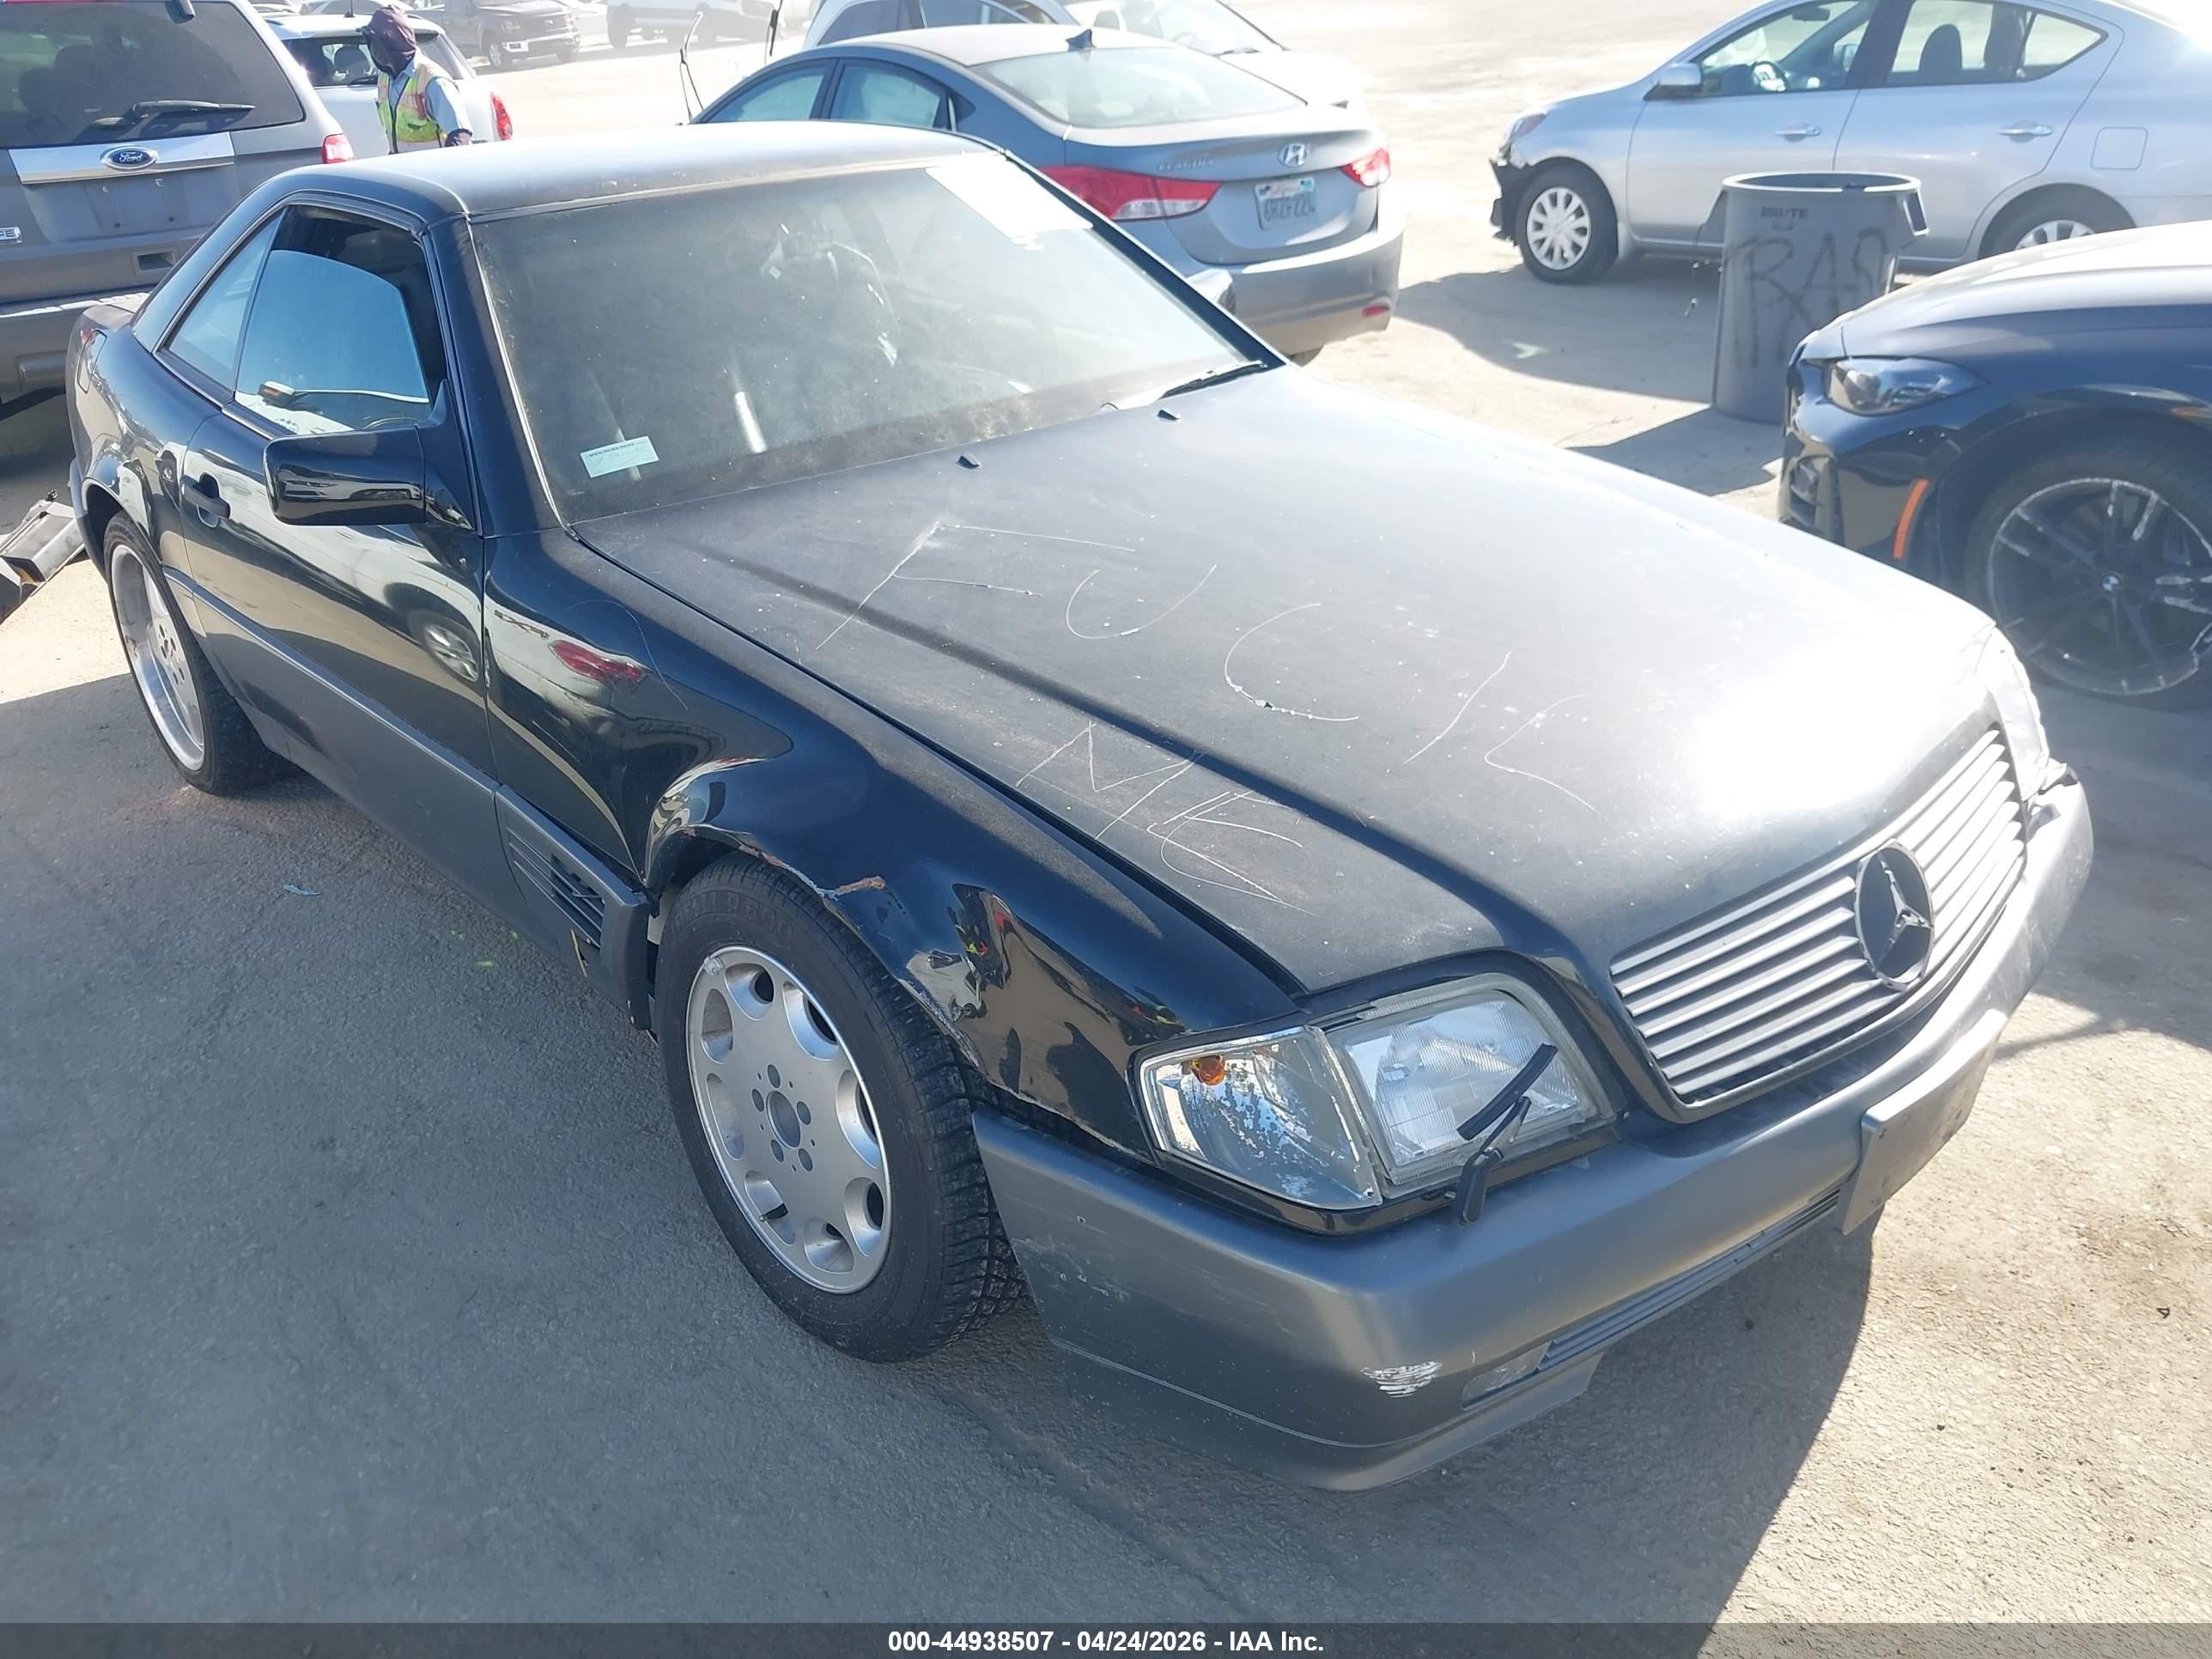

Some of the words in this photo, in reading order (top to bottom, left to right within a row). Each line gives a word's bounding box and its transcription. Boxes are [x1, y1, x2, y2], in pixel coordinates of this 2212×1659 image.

[119, 151, 143, 163] Ford
[1760, 206, 1809, 219] BRUTE
[816, 522, 1602, 820] FUCK
